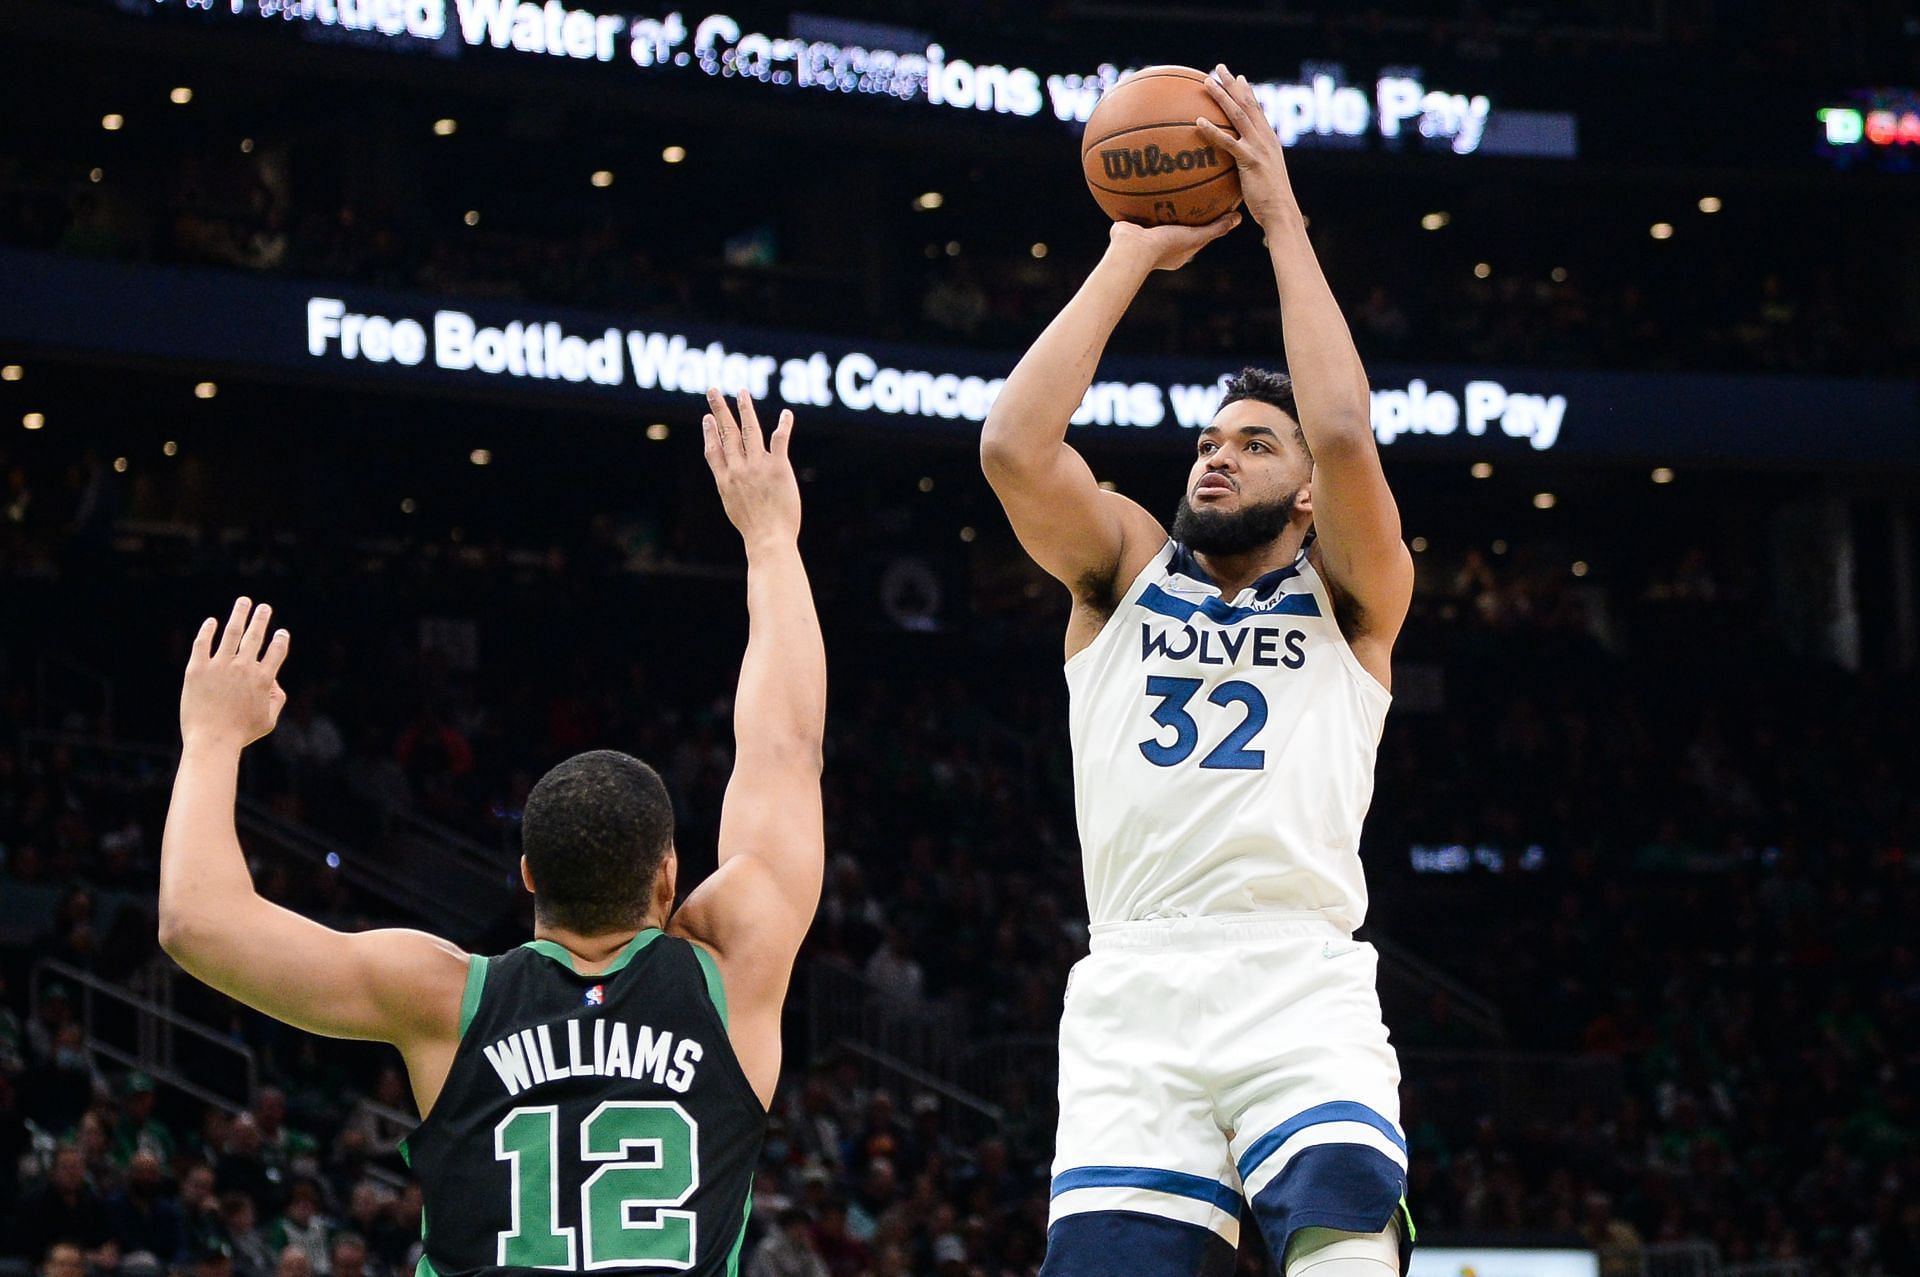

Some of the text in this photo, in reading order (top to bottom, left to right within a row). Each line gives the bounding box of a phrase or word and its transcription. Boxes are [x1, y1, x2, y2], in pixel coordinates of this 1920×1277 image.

[1376, 76, 1490, 154] Pay
[1100, 143, 1219, 181] Wilson
[307, 297, 427, 366] Free
[434, 309, 624, 386] Bottled
[626, 329, 777, 402] Water
[779, 351, 832, 407] at
[834, 352, 1165, 426] Conceons
[1368, 378, 1460, 445] ple
[1464, 380, 1567, 451] Pay
[1141, 622, 1307, 670] WOLVES
[1138, 674, 1269, 770] 32
[483, 1018, 704, 1097] WILLIAMS
[494, 1100, 700, 1272] 12
